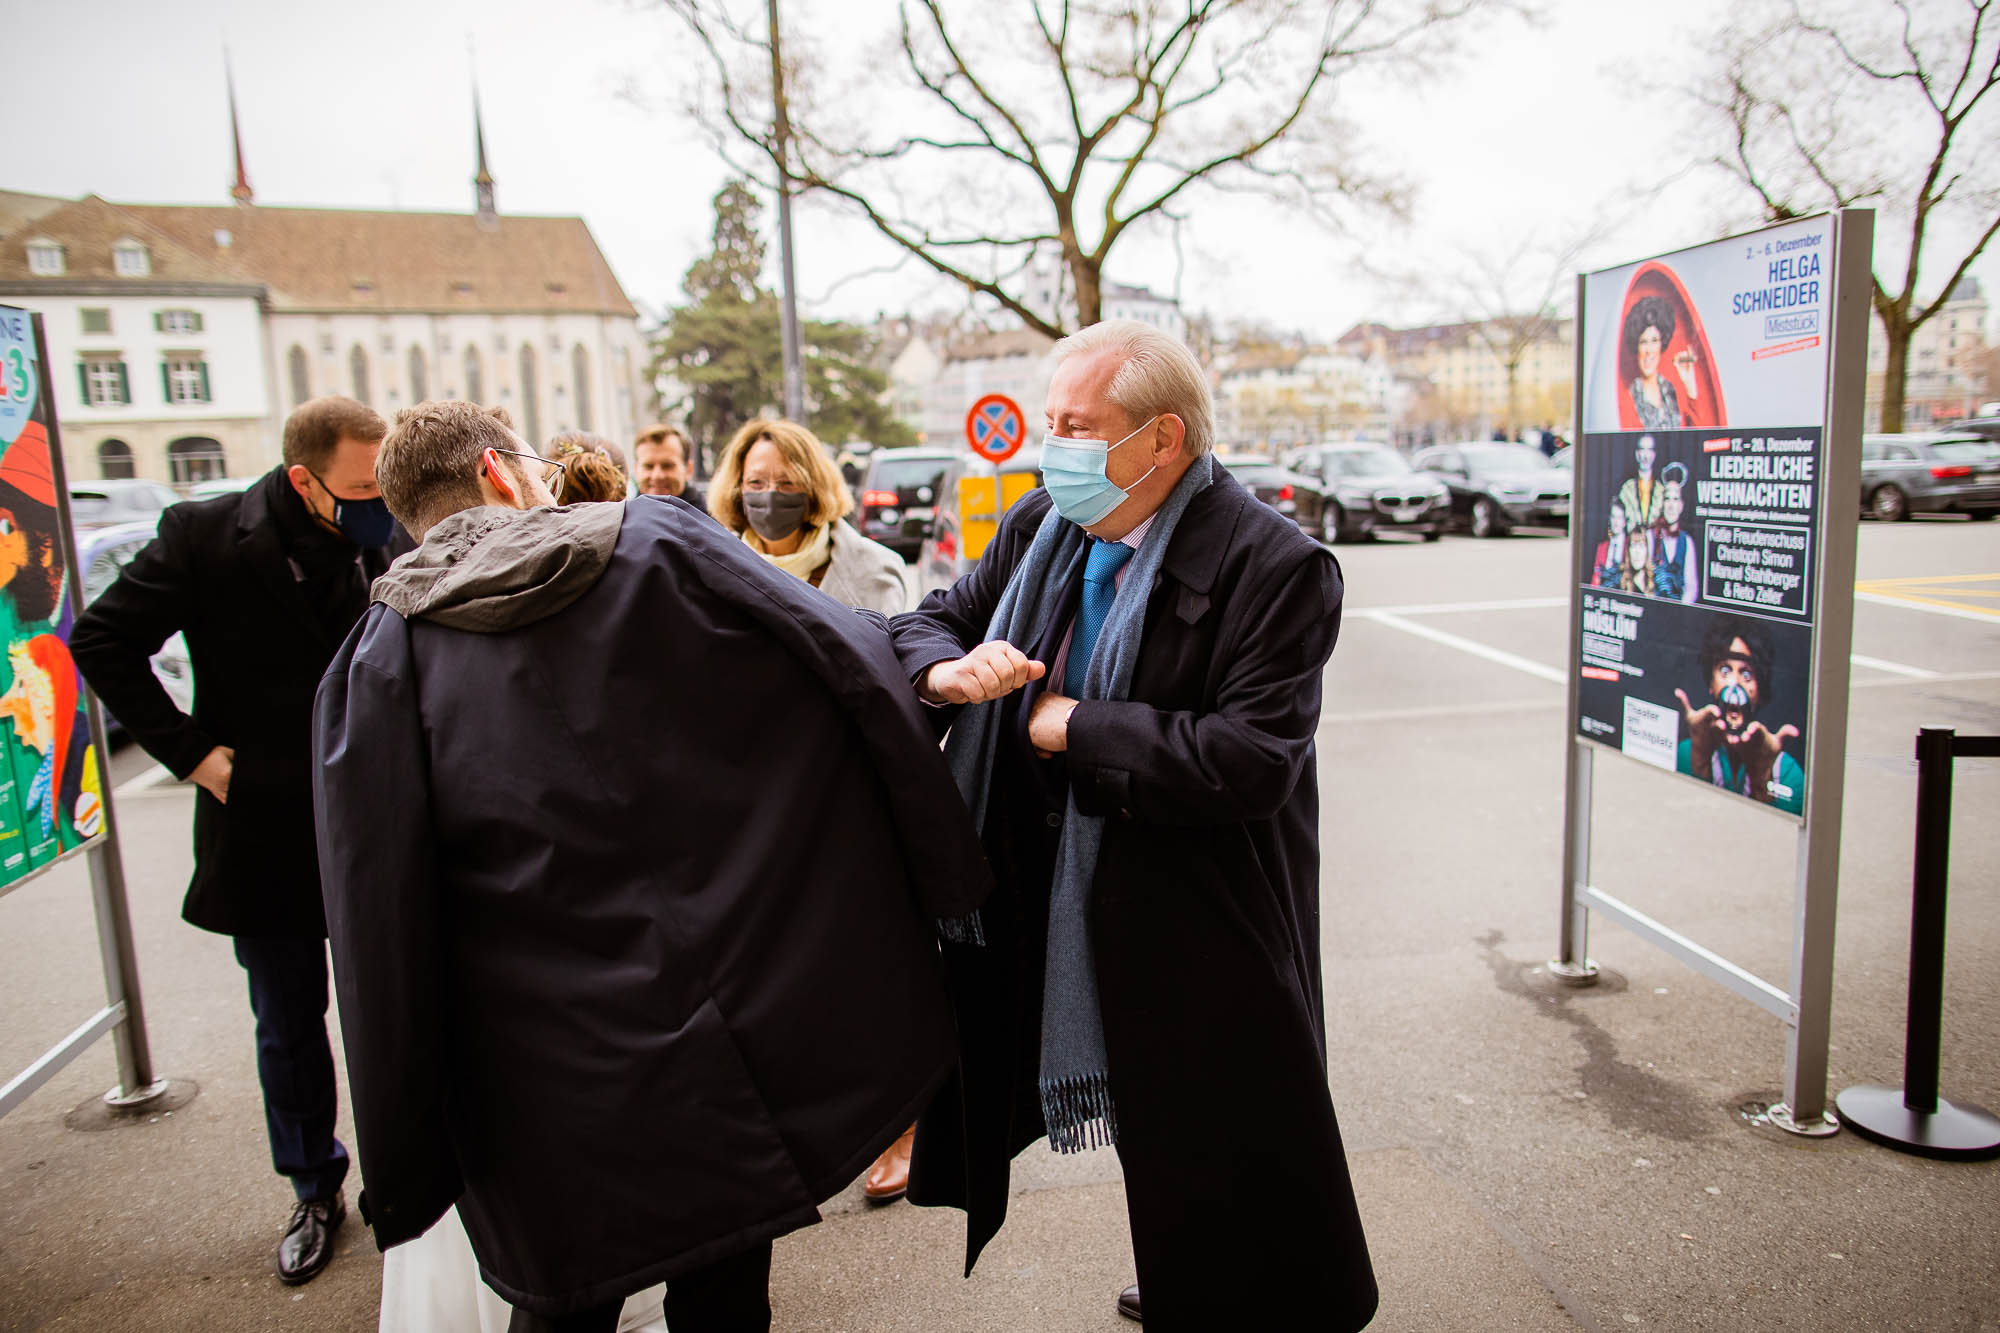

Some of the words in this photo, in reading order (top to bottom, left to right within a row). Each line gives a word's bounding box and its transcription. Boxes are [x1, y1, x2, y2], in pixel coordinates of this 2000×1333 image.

[1775, 234, 1823, 254] Dezember
[1768, 253, 1820, 283] HELGA
[1732, 281, 1819, 315] SCHNEIDER
[1766, 437, 1815, 453] Dezember
[1710, 455, 1814, 481] LIEDERLICHE
[1696, 480, 1812, 509] WEIHNACHTEN
[1732, 527, 1805, 550] Freudenschuss
[1717, 544, 1760, 565] Christoph
[1761, 549, 1794, 569] Simon
[1710, 561, 1743, 581] Manuel
[1723, 581, 1732, 598] &
[1732, 583, 1755, 601] Reto
[1626, 702, 1660, 720] Theater
